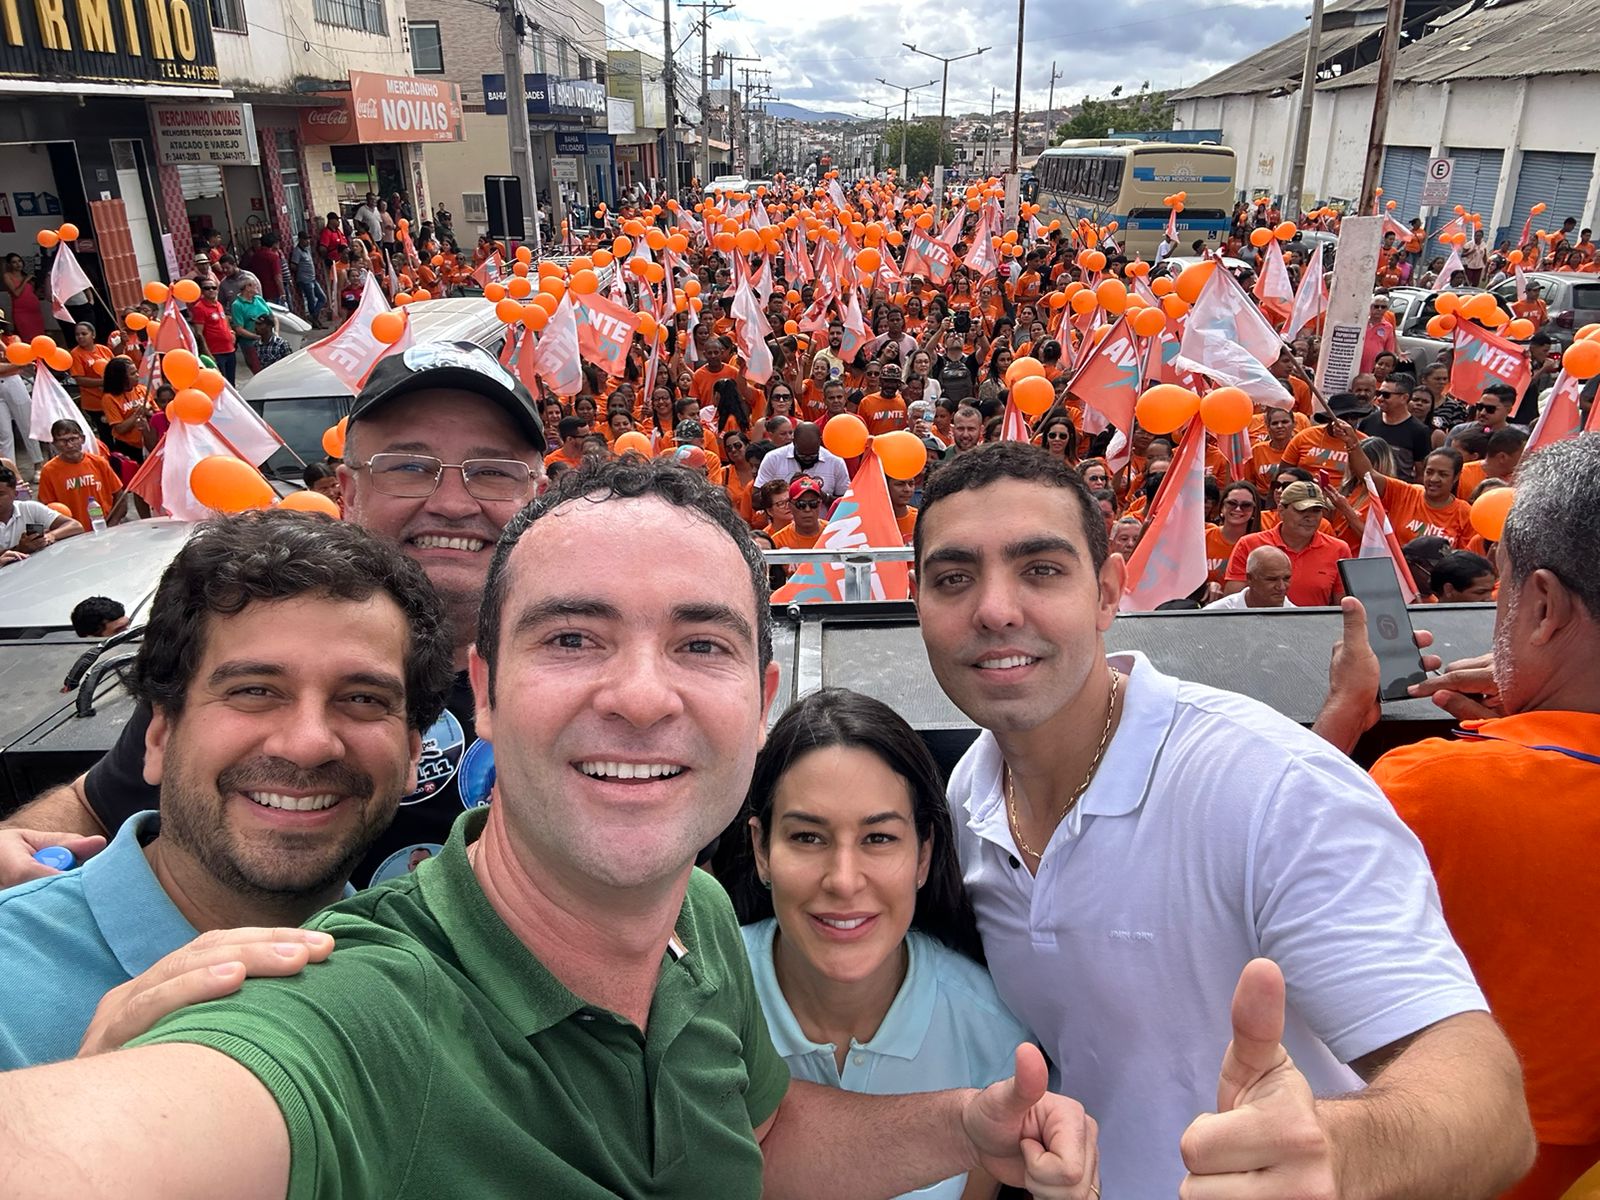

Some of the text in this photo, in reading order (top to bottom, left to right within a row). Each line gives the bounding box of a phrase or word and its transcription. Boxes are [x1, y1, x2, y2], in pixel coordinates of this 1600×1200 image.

[161, 63, 181, 78] TEL
[182, 65, 200, 80] 3441
[386, 79, 439, 97] MERCADINHO
[487, 91, 507, 100] BAHIA
[158, 110, 241, 127] MERCADINHO NOVAIS
[381, 98, 448, 131] NOVAIS
[161, 129, 191, 137] MELHORES
[191, 129, 213, 138] PREÇOS
[222, 128, 242, 136] CIDADE
[170, 140, 240, 150] ATACADO E VAREJO
[1436, 163, 1445, 176] E
